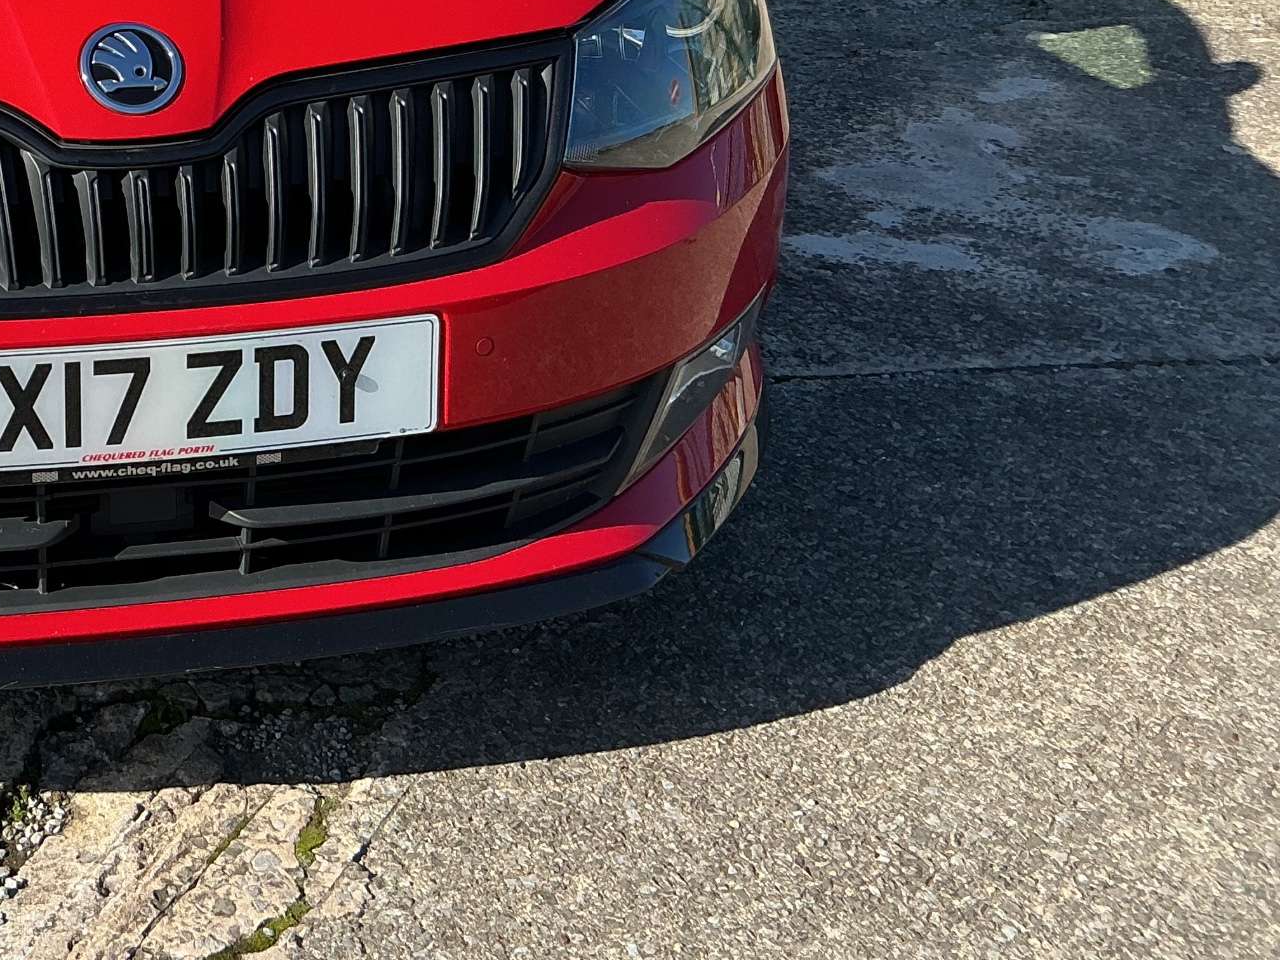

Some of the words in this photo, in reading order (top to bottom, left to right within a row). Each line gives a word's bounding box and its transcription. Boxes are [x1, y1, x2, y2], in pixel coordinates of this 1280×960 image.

[186, 335, 376, 439] ZDY
[81, 450, 146, 463] CHEQUERED
[149, 446, 174, 458] FLAG
[177, 444, 216, 456] PORTH
[72, 456, 240, 480] www.cheq-flag.co.uk
